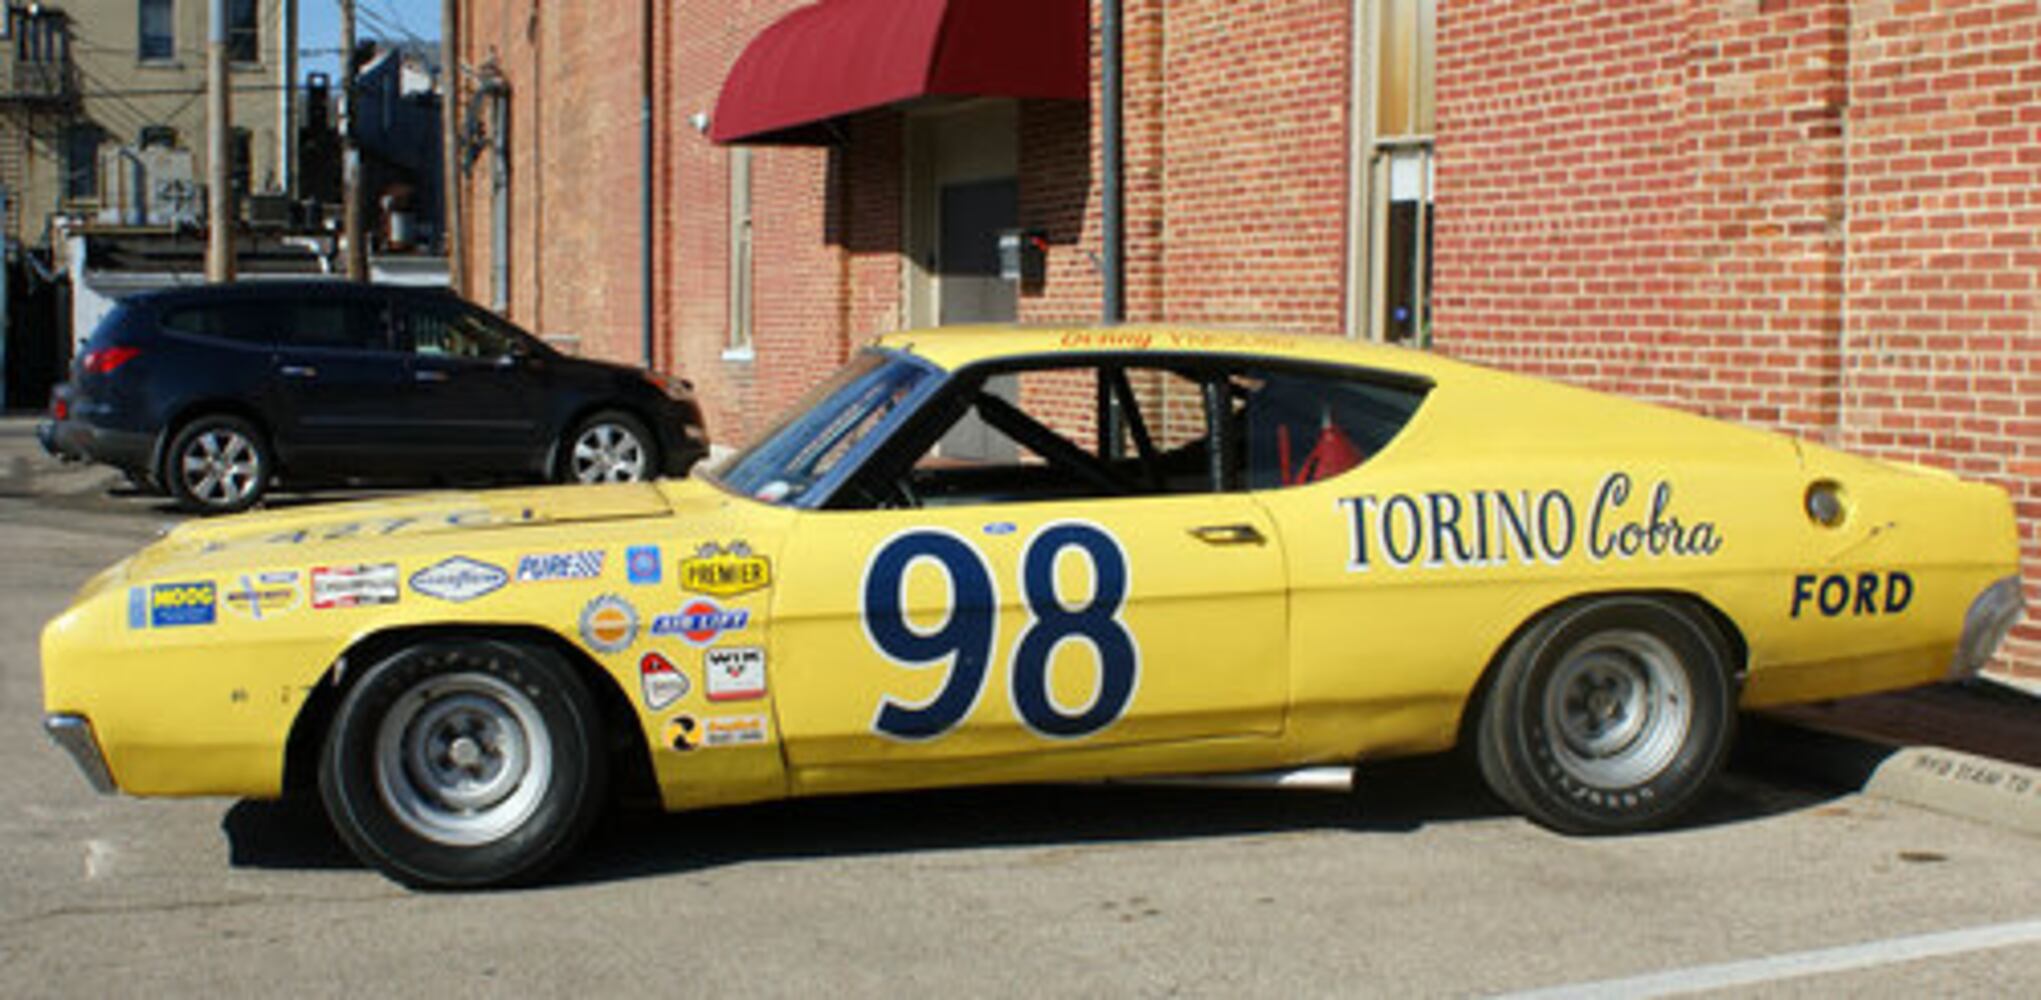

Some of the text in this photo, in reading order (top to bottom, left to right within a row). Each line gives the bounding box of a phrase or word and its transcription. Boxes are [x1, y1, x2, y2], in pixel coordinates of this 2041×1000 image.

[1338, 472, 1723, 571] TORINO Cobra
[153, 587, 214, 606] MOOG
[688, 562, 762, 586] PREMIER
[1790, 571, 1914, 618] FORD
[860, 520, 1143, 744] 98
